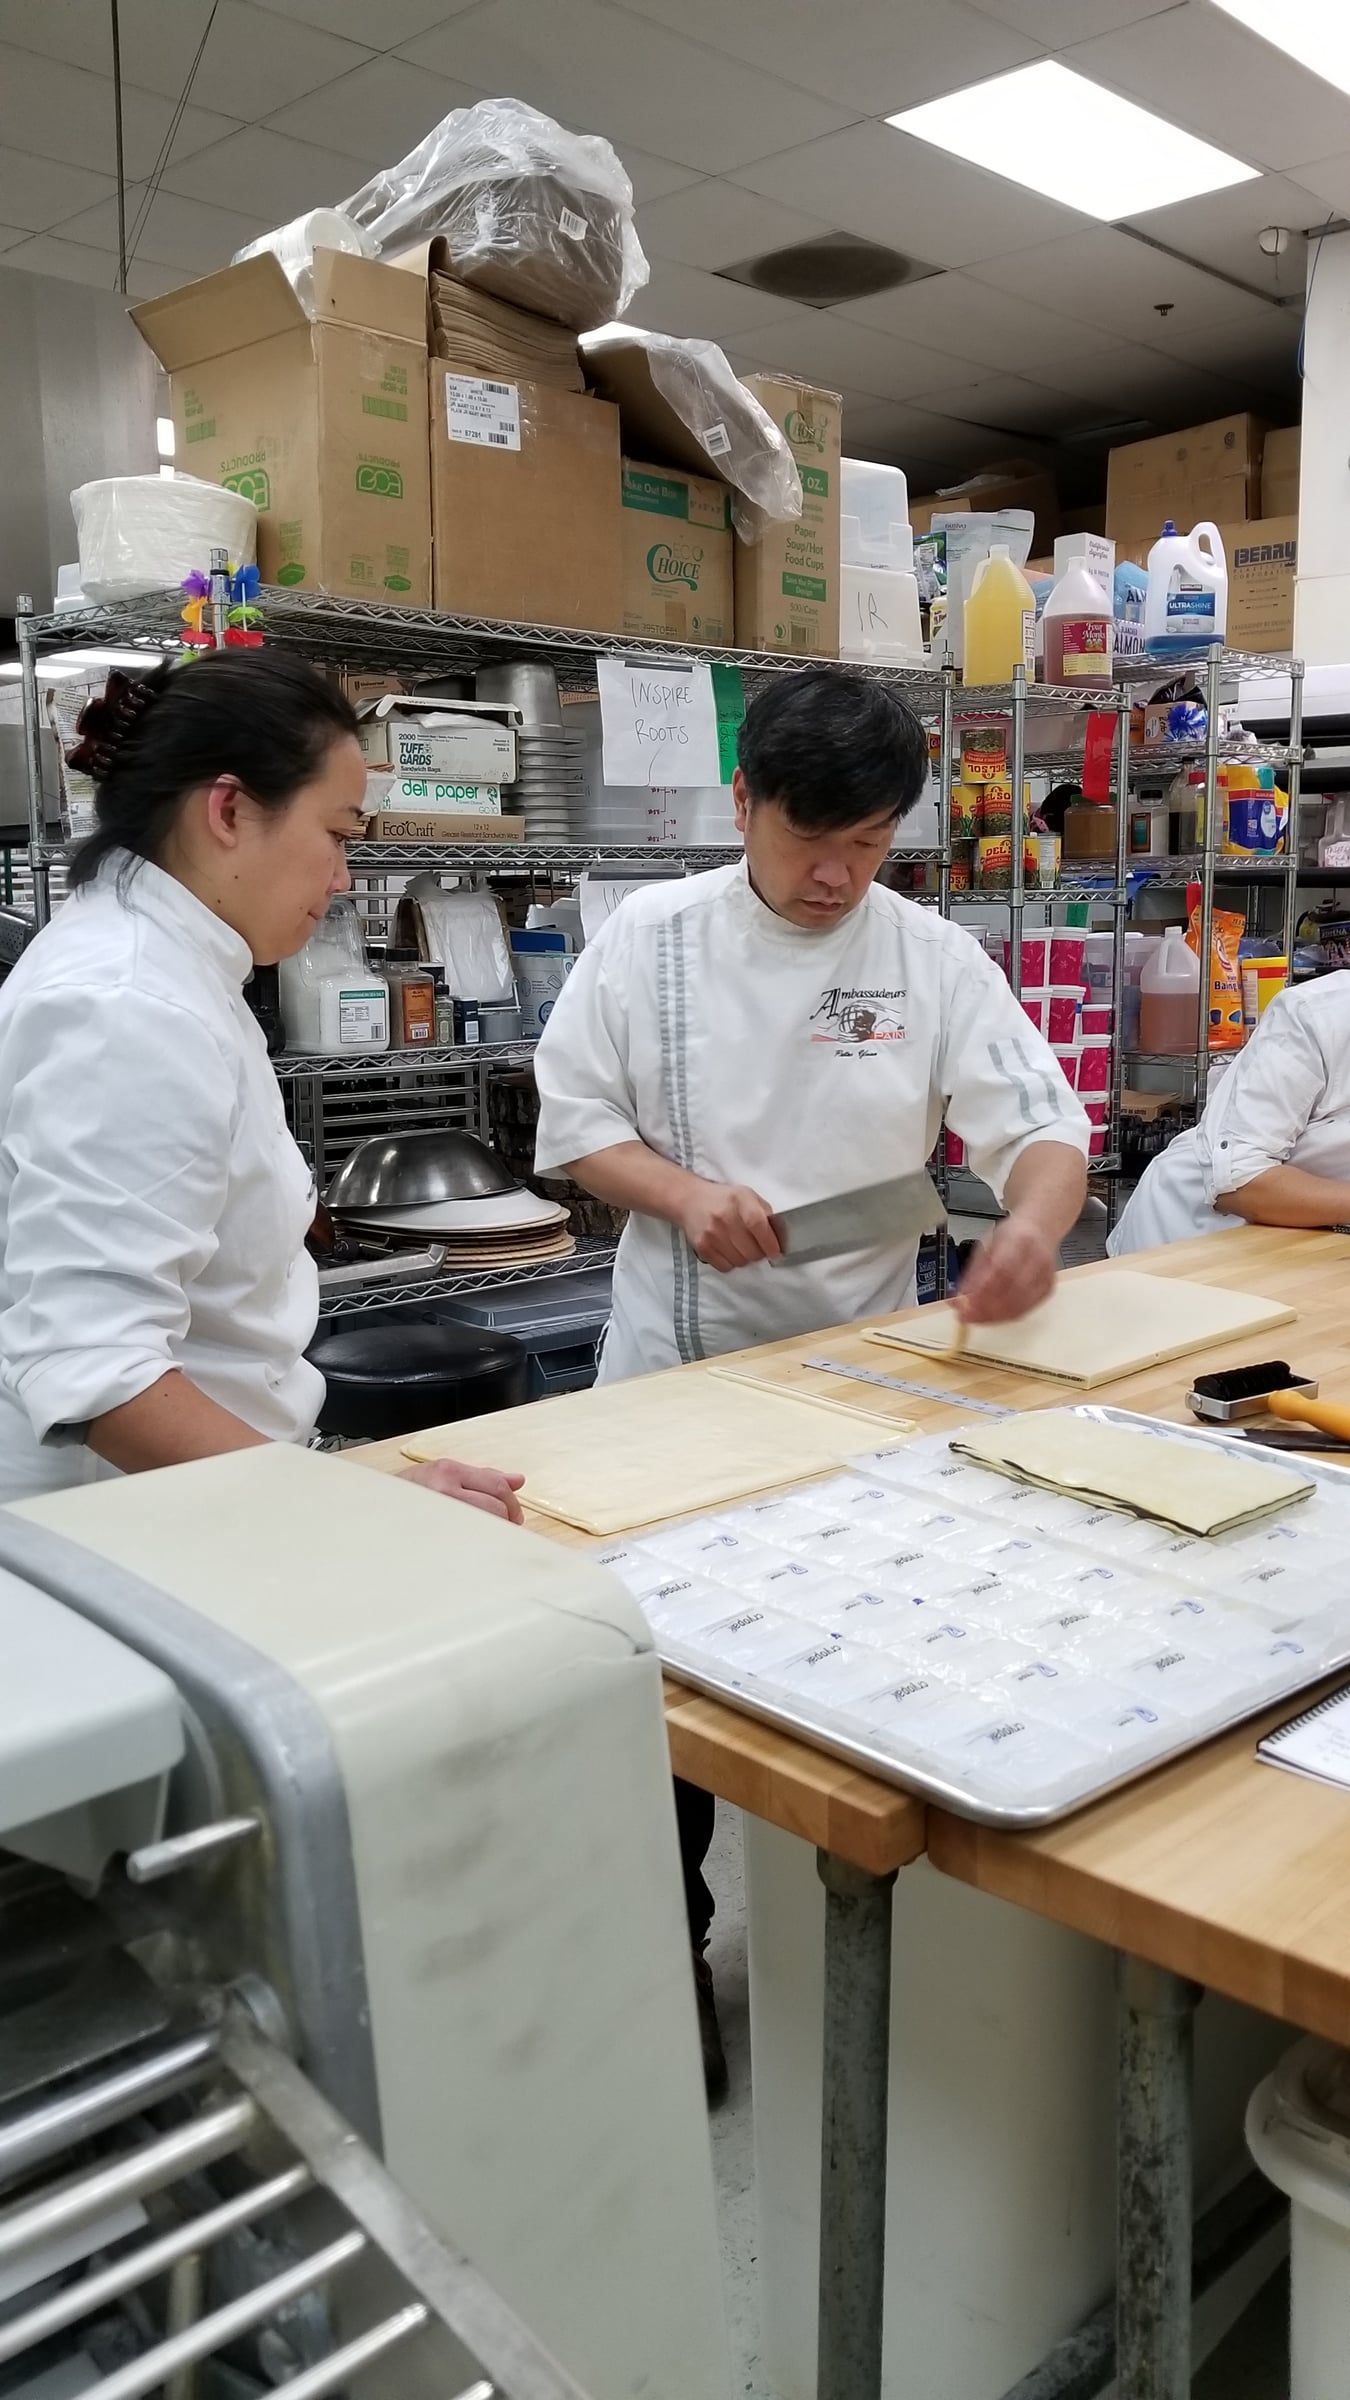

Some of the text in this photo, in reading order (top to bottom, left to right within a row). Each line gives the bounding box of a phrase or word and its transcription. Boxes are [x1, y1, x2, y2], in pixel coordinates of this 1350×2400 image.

[220, 452, 266, 473] PRODUCTS
[357, 453, 401, 468] PRODUCTS
[794, 523, 816, 539] Paper
[786, 537, 824, 556] Soup/Hot
[1234, 541, 1297, 568] BERRY
[646, 543, 701, 592] CHOICE
[785, 552, 825, 572] Food Cups
[1113, 632, 1146, 655] ALMON
[631, 677, 693, 710] INSPIRE
[398, 733, 416, 741] 2000
[635, 718, 689, 745] ROOTS
[400, 742, 424, 755] TUFF
[400, 754, 432, 766] GARDS
[401, 779, 480, 802] deli paper
[986, 846, 1005, 857] DEL
[809, 987, 907, 1020] Ambassadeurs
[874, 1031, 906, 1040] PAIN
[656, 1581, 692, 1599] cryopak
[729, 1612, 764, 1634] cryopak
[804, 1644, 842, 1667] cryopak
[892, 1680, 929, 1702] cryopak
